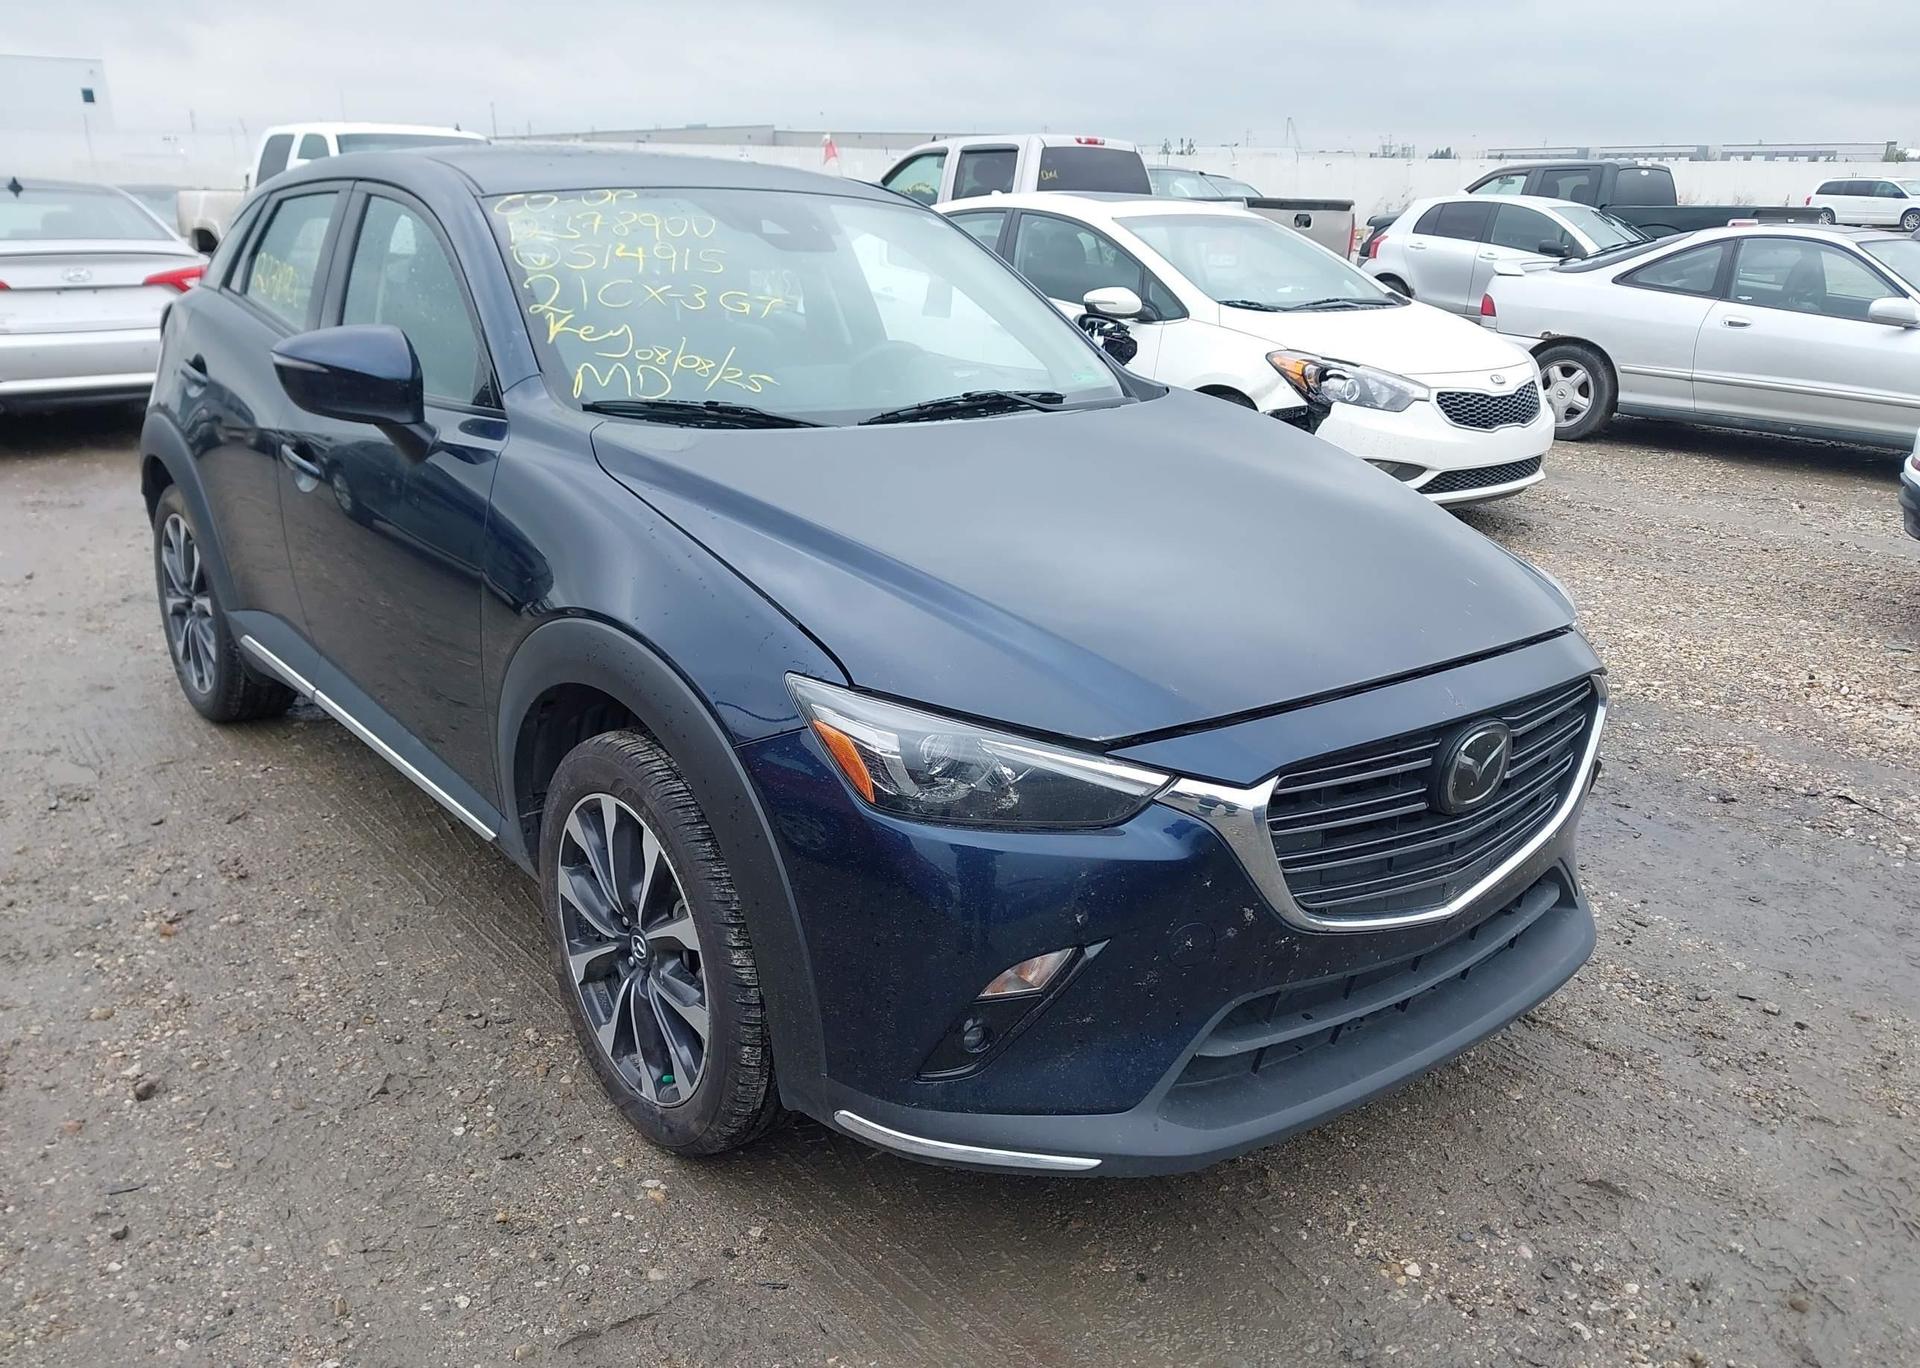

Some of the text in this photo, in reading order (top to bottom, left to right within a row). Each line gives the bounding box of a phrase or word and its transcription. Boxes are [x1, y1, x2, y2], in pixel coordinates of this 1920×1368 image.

[545, 311, 633, 358] Key
[572, 362, 673, 399] MD
[635, 336, 781, 393] 08/08/25
